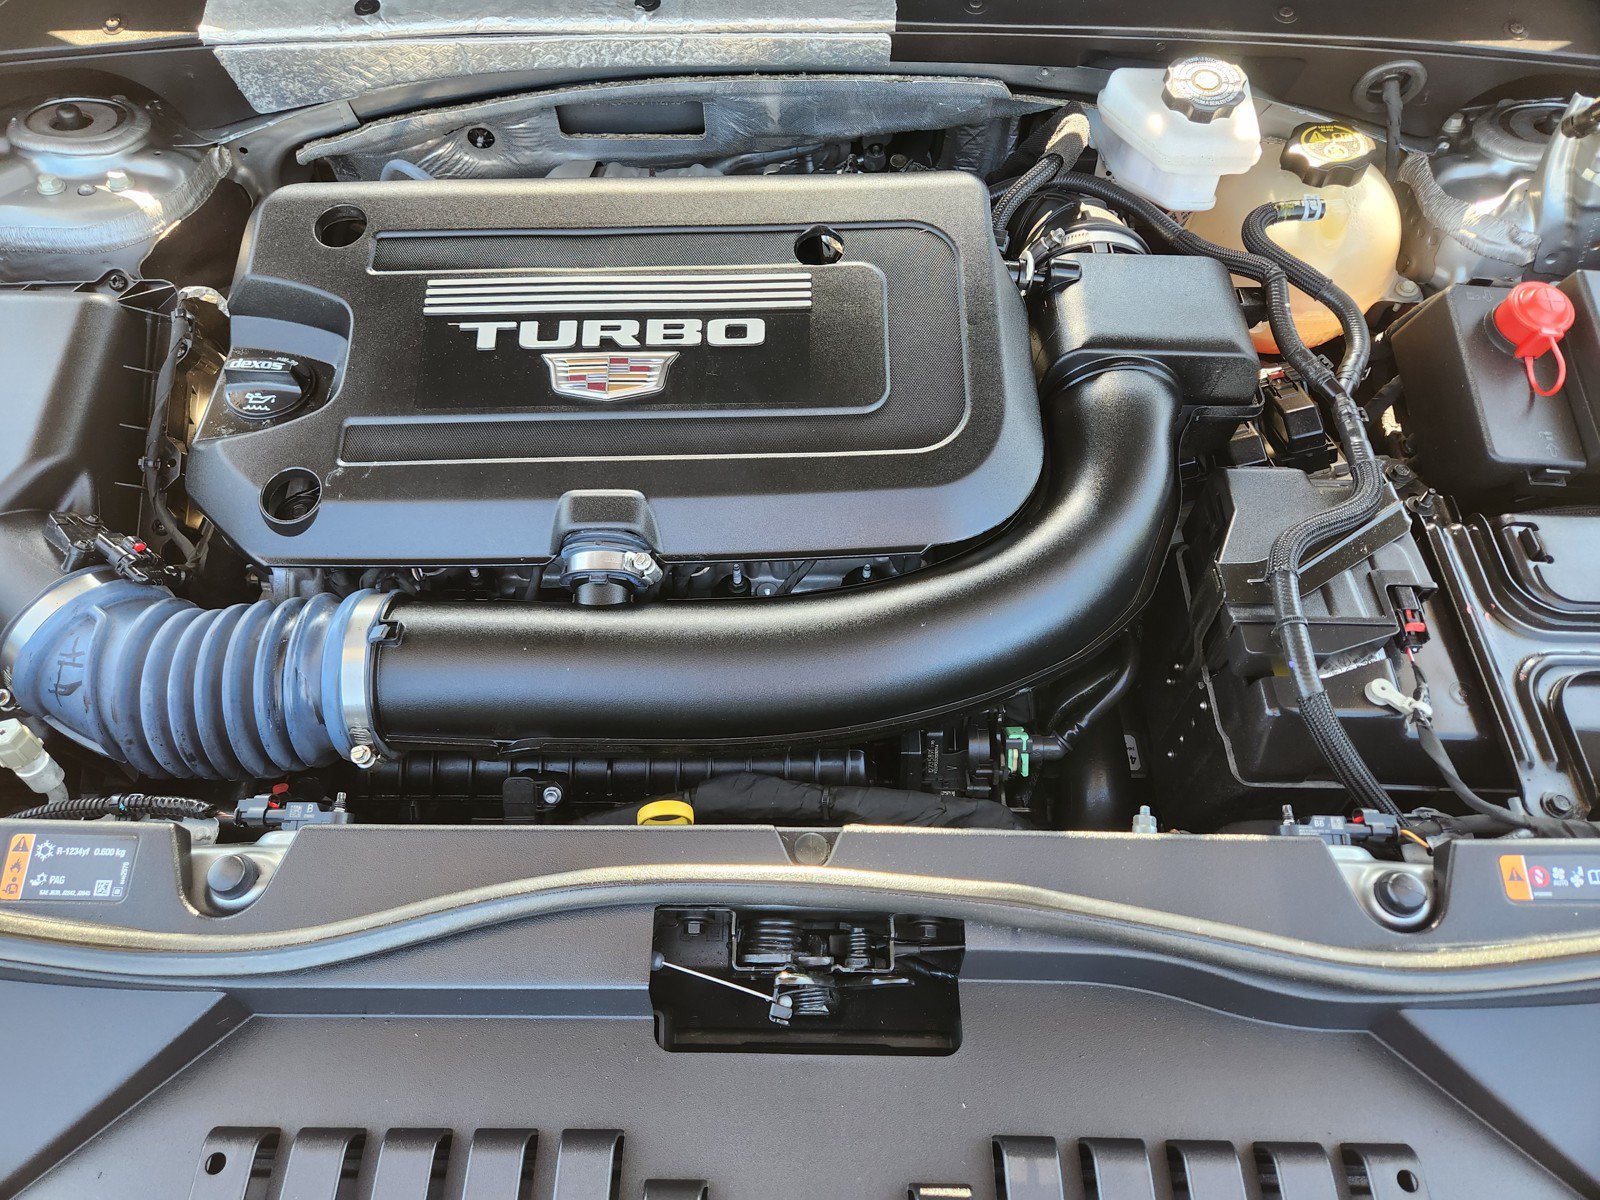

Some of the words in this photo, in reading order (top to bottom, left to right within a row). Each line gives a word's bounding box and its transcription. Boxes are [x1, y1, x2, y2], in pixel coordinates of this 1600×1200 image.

[448, 317, 766, 351] TURBO
[229, 358, 286, 370] dexos
[115, 848, 126, 858] kg
[48, 875, 66, 885] PAG
